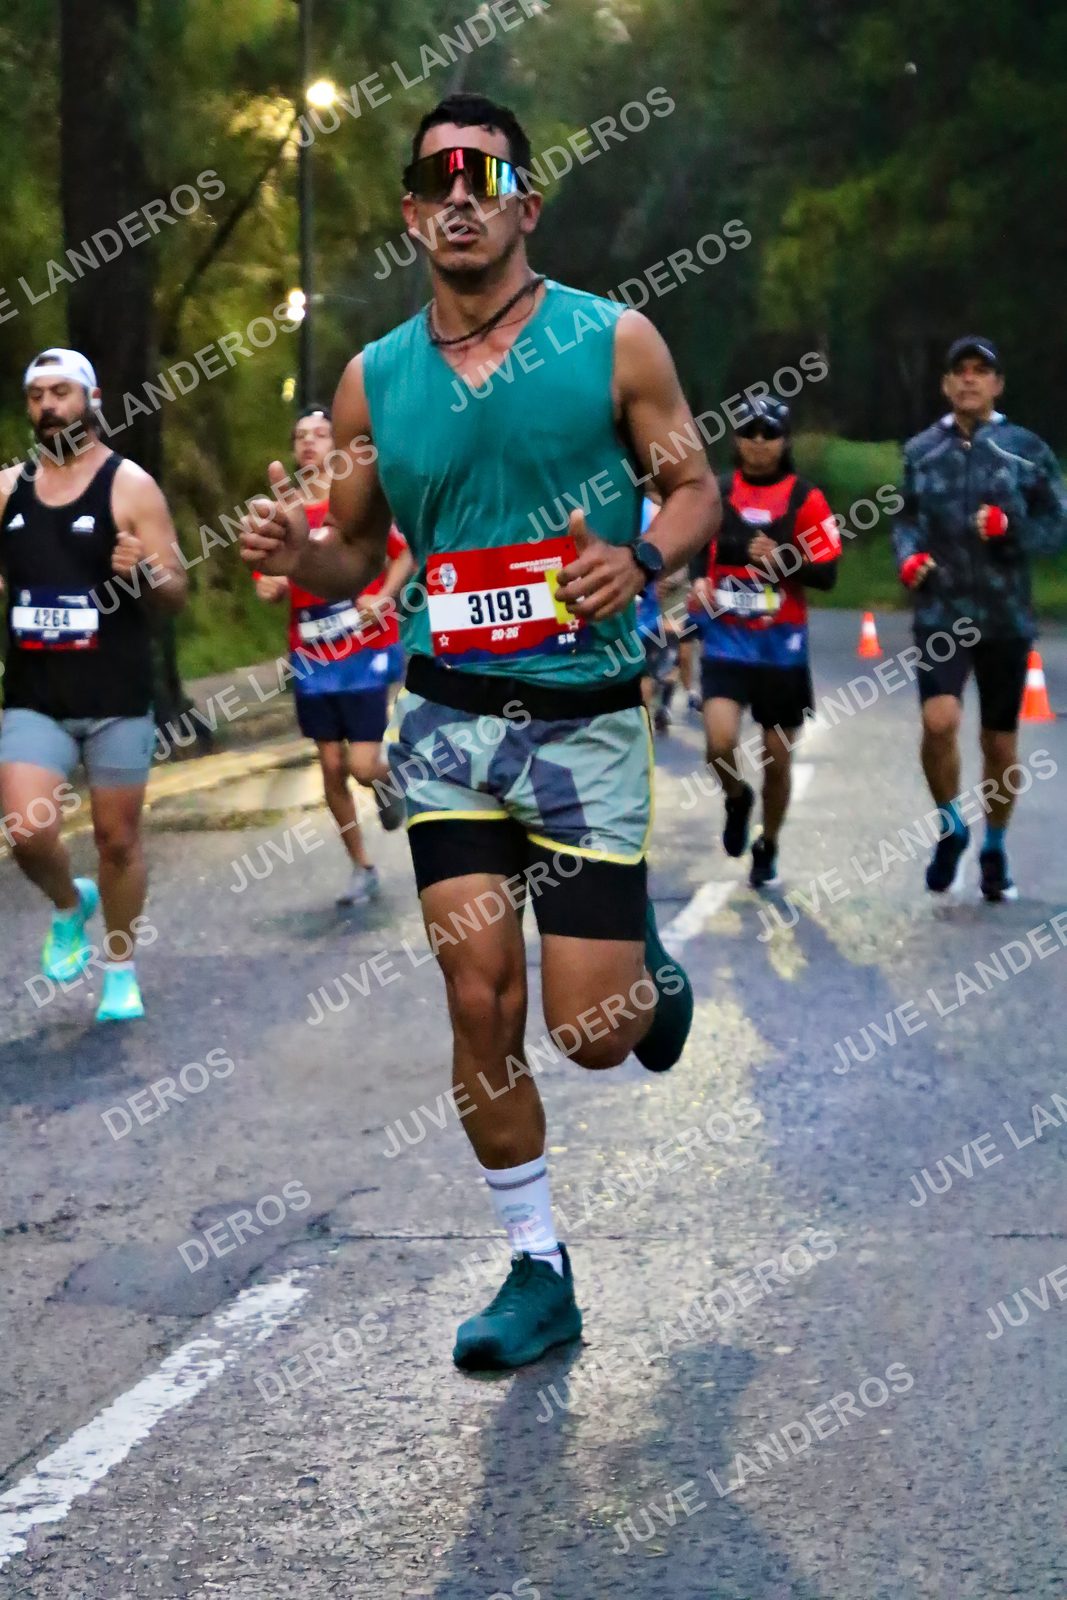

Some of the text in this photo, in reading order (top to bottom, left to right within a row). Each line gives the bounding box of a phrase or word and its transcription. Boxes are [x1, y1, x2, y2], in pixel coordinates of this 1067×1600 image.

[468, 587, 533, 625] 3193
[34, 608, 71, 628] 4264
[558, 632, 577, 644] 5K
